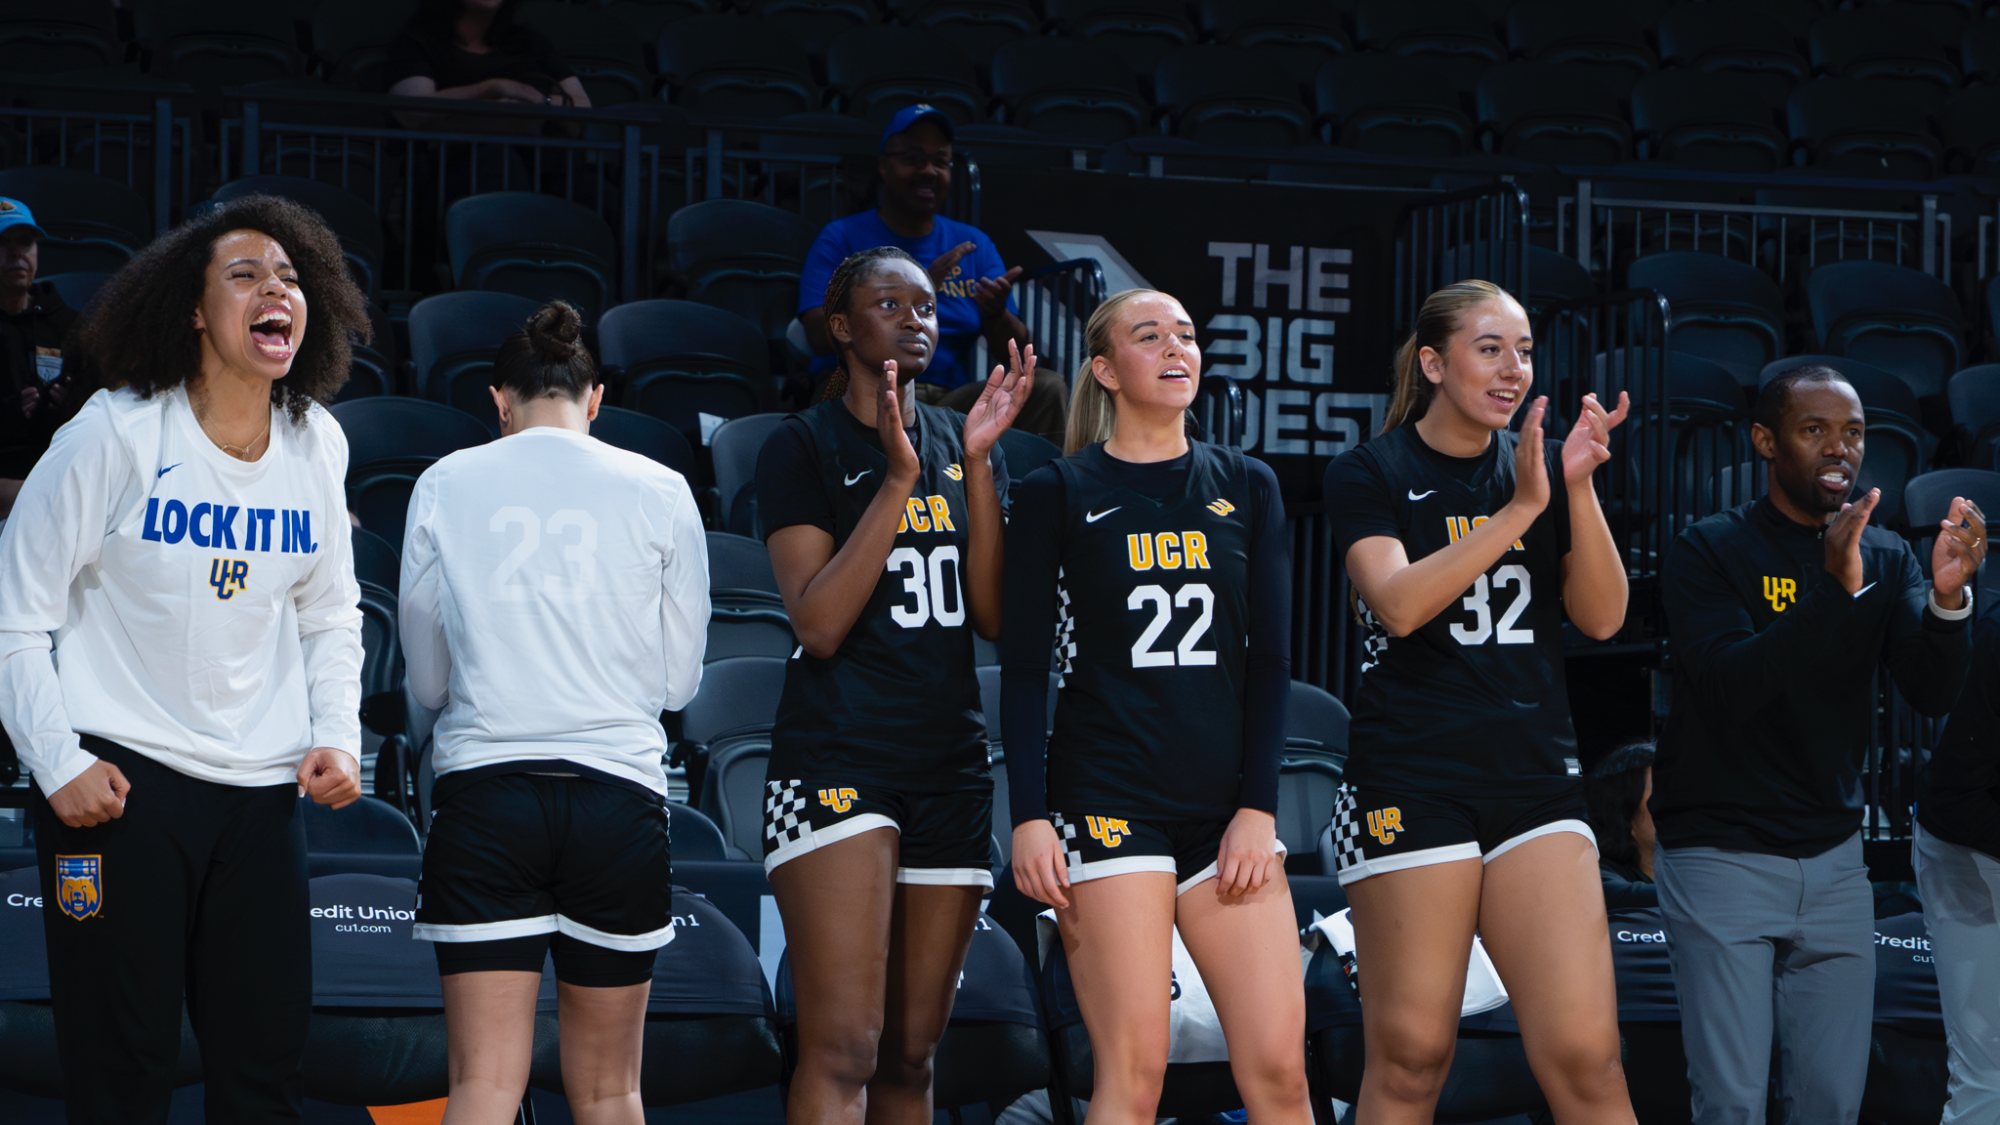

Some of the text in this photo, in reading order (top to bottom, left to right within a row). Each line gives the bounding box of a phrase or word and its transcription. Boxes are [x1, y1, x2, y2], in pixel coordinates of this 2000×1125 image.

[1207, 241, 1353, 314] THE
[1203, 313, 1336, 385] BIG
[141, 497, 318, 554] LOCK IT IN.
[488, 506, 598, 606] 23
[1127, 530, 1212, 572] UCR
[886, 545, 966, 629] 30
[1449, 564, 1535, 646] 32
[1127, 583, 1218, 669] 22
[6, 893, 44, 908] Cre
[309, 904, 354, 919] edit
[335, 923, 392, 934] cu1.com
[1616, 929, 1667, 943] Cred
